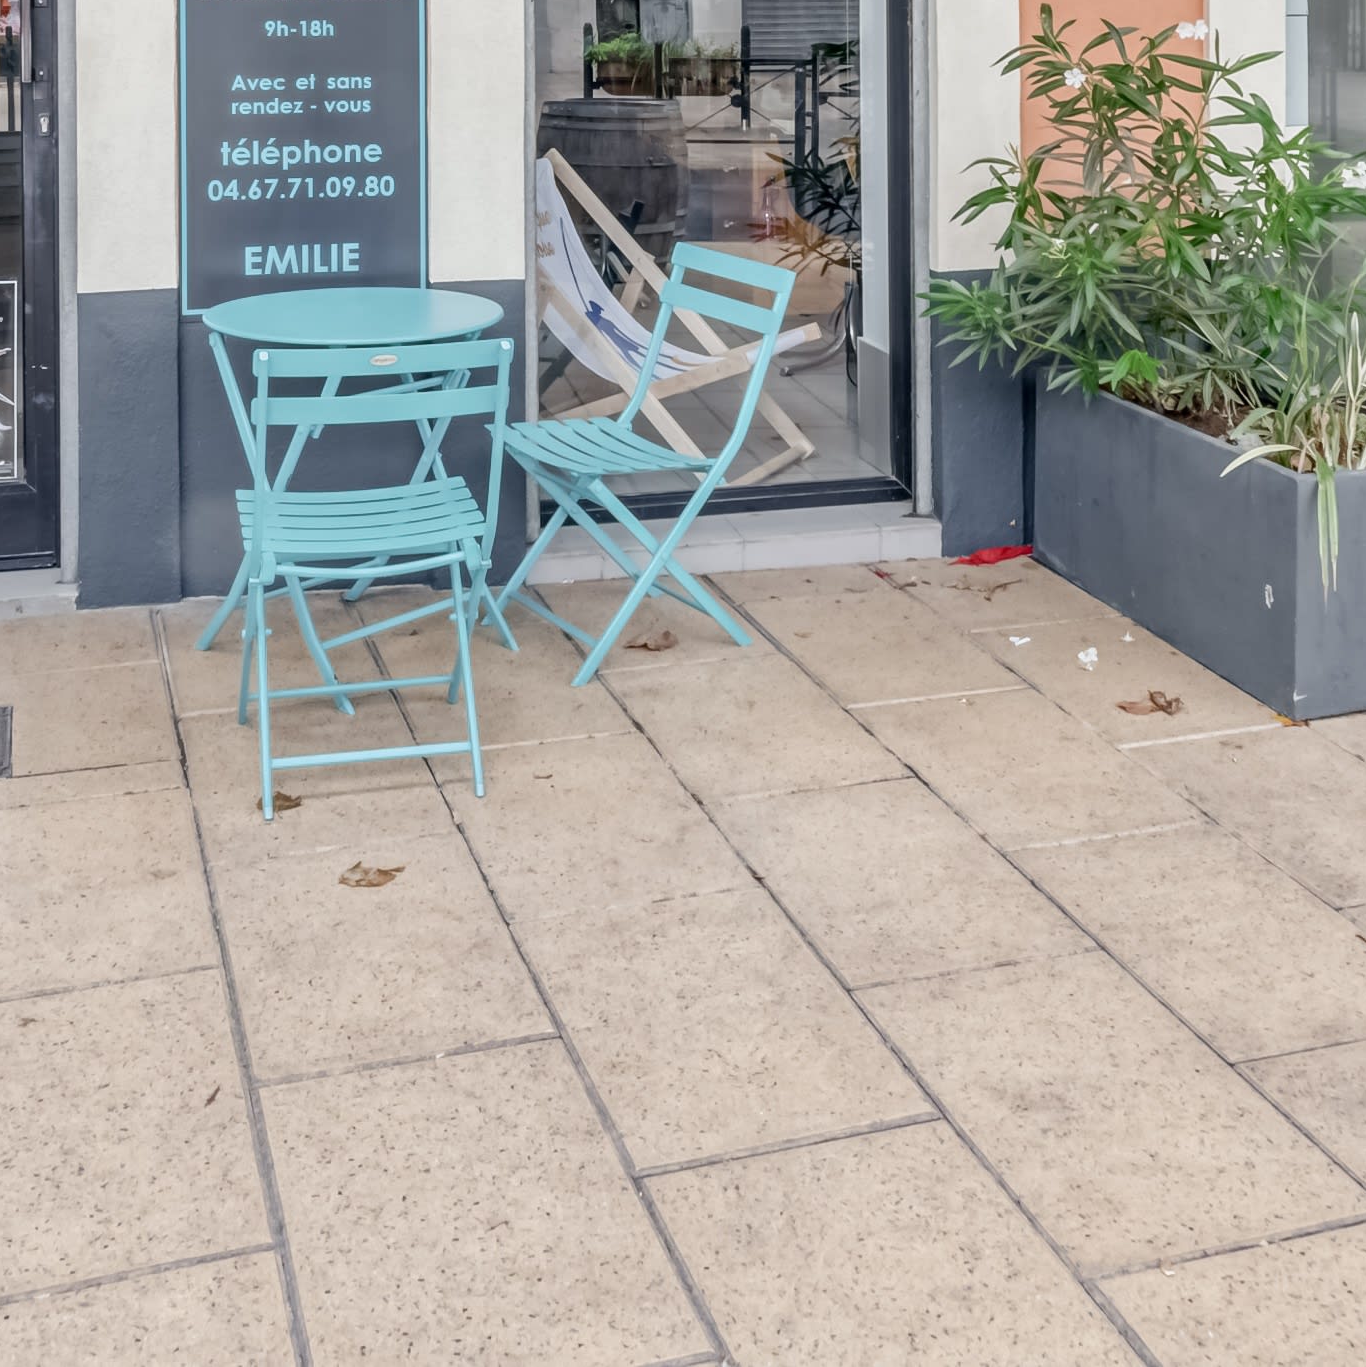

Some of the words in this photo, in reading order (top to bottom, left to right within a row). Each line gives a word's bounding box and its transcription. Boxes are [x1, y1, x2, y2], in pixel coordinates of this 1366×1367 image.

[264, 20, 335, 37] 9h-18h
[231, 75, 286, 91] Avec
[296, 74, 316, 90] et
[327, 76, 372, 90] sans
[231, 98, 304, 116] rendez
[324, 98, 372, 114] vous
[220, 137, 383, 171] téléphone
[207, 175, 395, 202] 04.67.71.09.80
[244, 242, 360, 276] EMILIE
